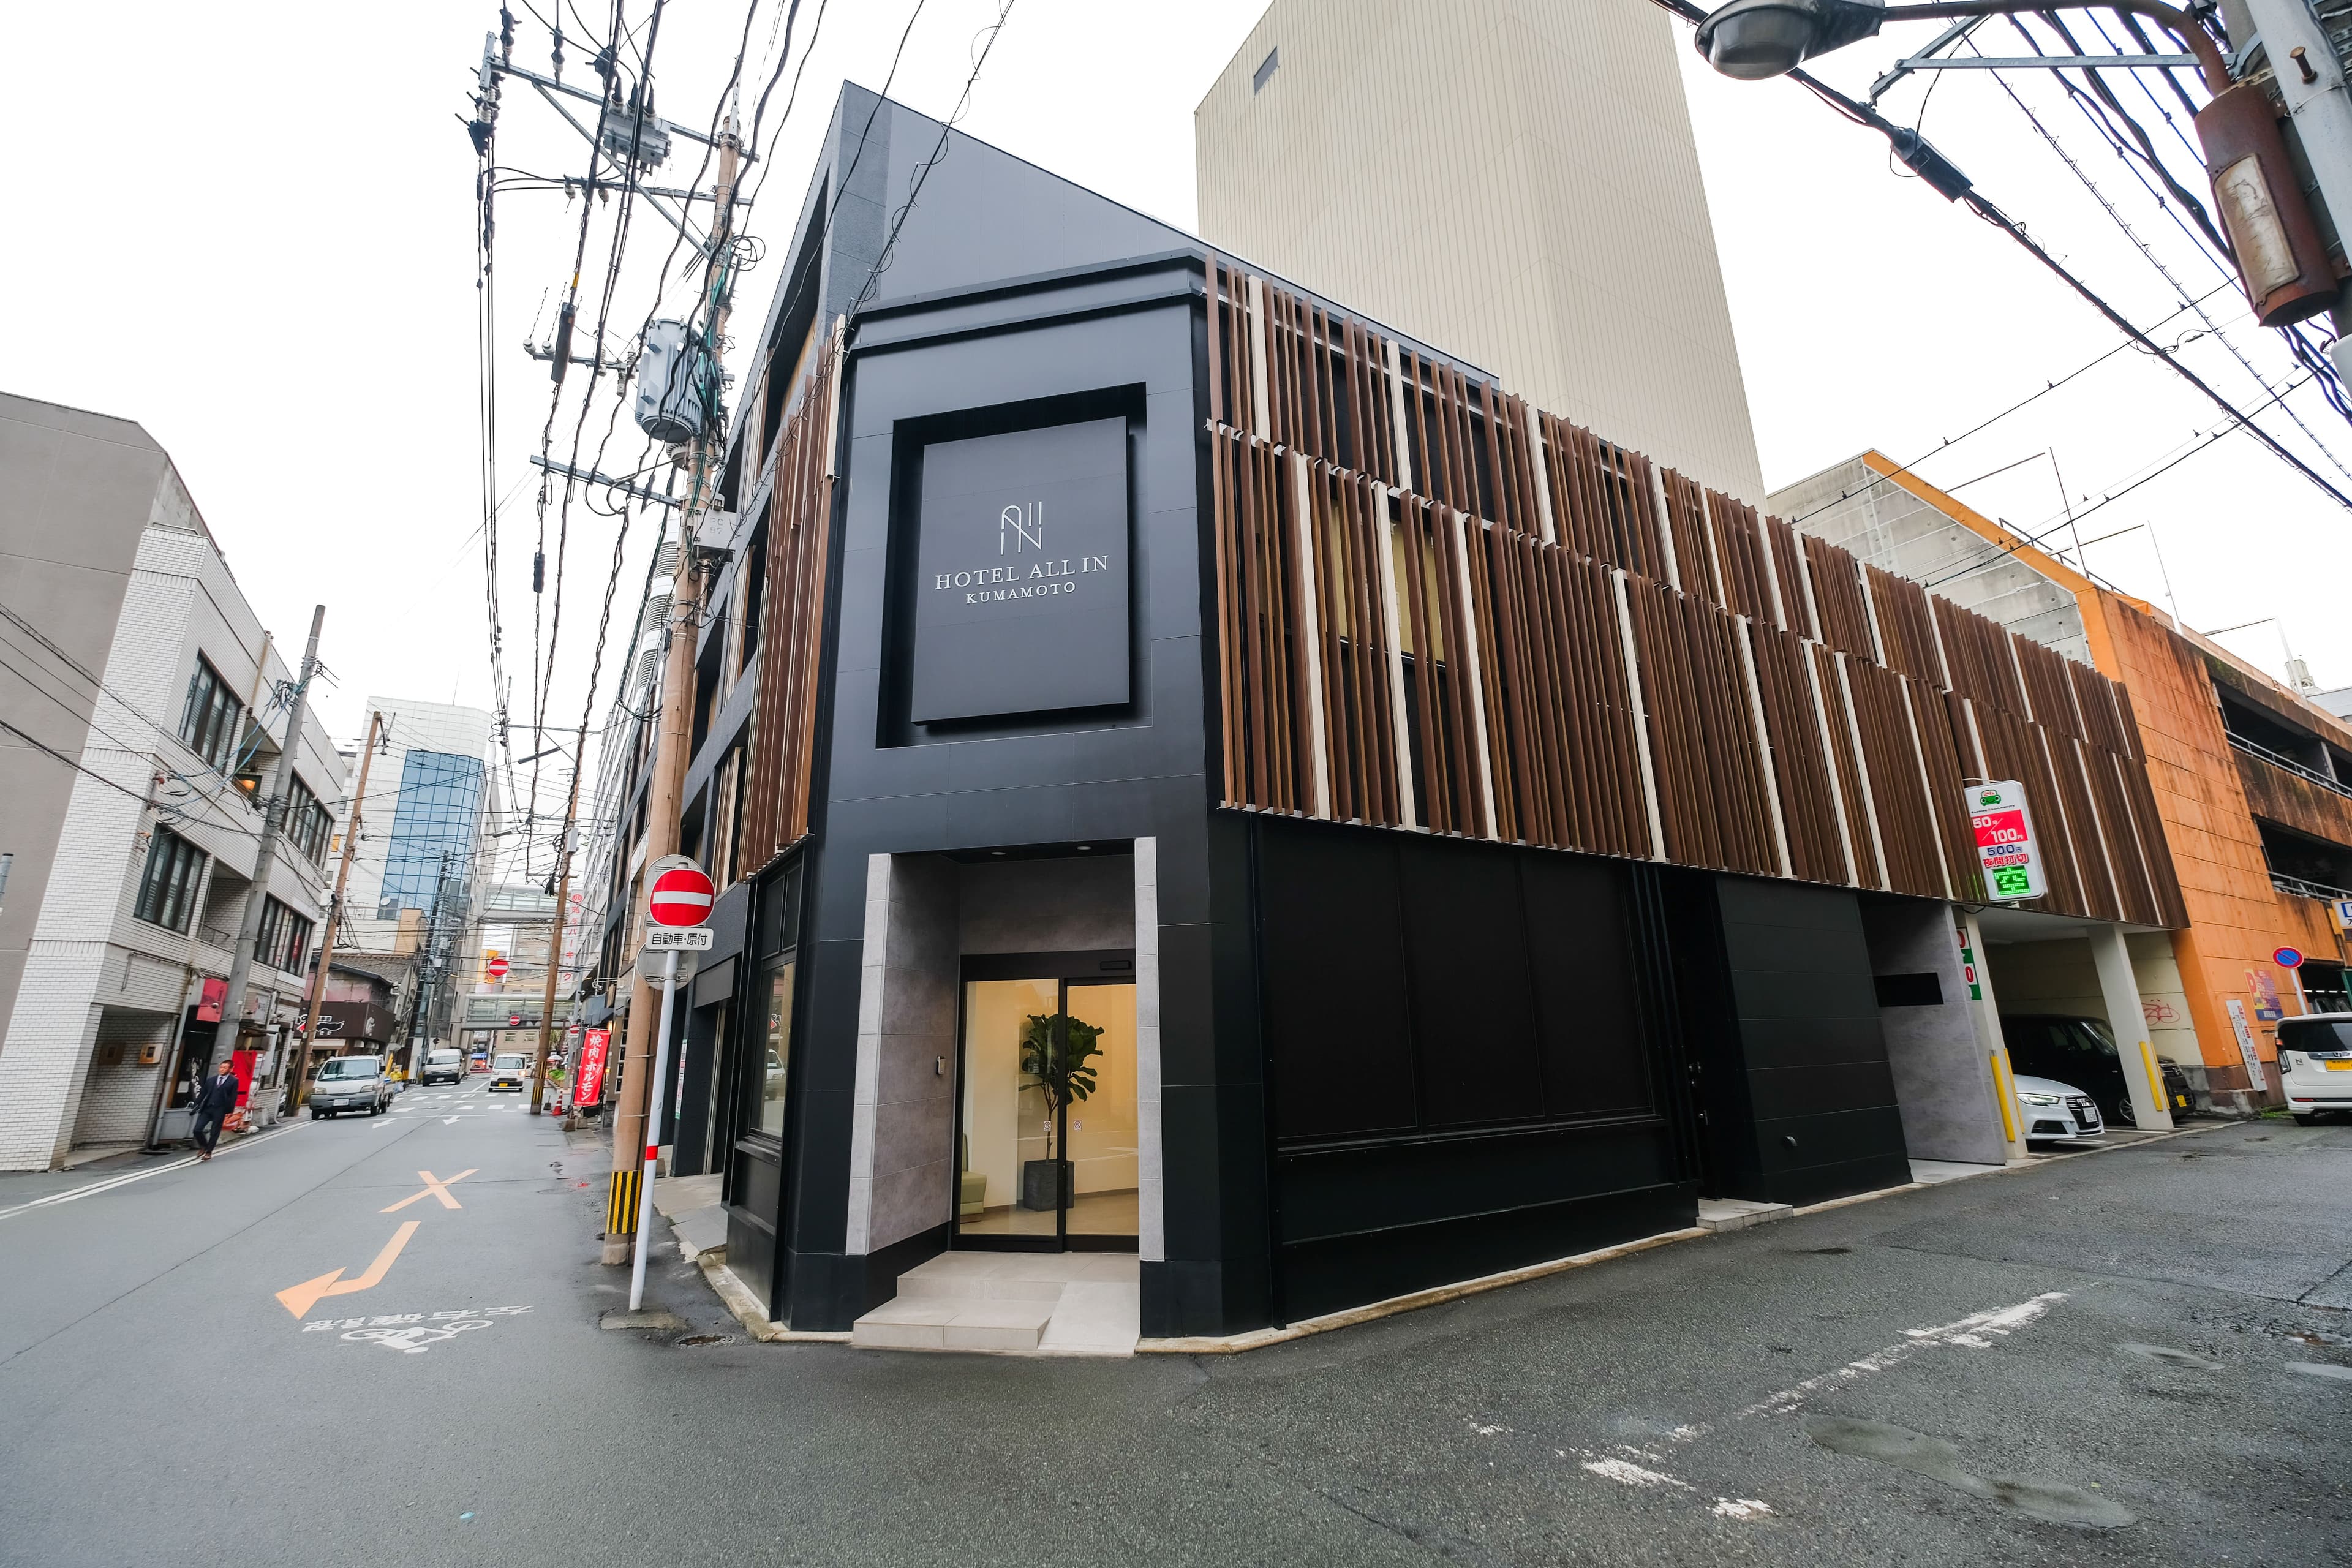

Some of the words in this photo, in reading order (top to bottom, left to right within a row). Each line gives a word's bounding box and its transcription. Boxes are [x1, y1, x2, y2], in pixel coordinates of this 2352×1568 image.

[935, 567, 1020, 590] HOTEL
[1028, 559, 1076, 579] ALL
[1081, 555, 1109, 573] IN
[965, 582, 1076, 604] KUMAMOTO
[1991, 828, 2024, 843] 100円
[1982, 854, 2029, 867] 夜間打切
[1987, 844, 2023, 856] 500円
[1994, 867, 2030, 895] 空
[563, 907, 580, 981] パーキグ
[652, 932, 707, 946] 自動車・原付
[581, 1035, 603, 1101] 焼肉・ホルモン
[303, 1305, 535, 1332] 左右確認
